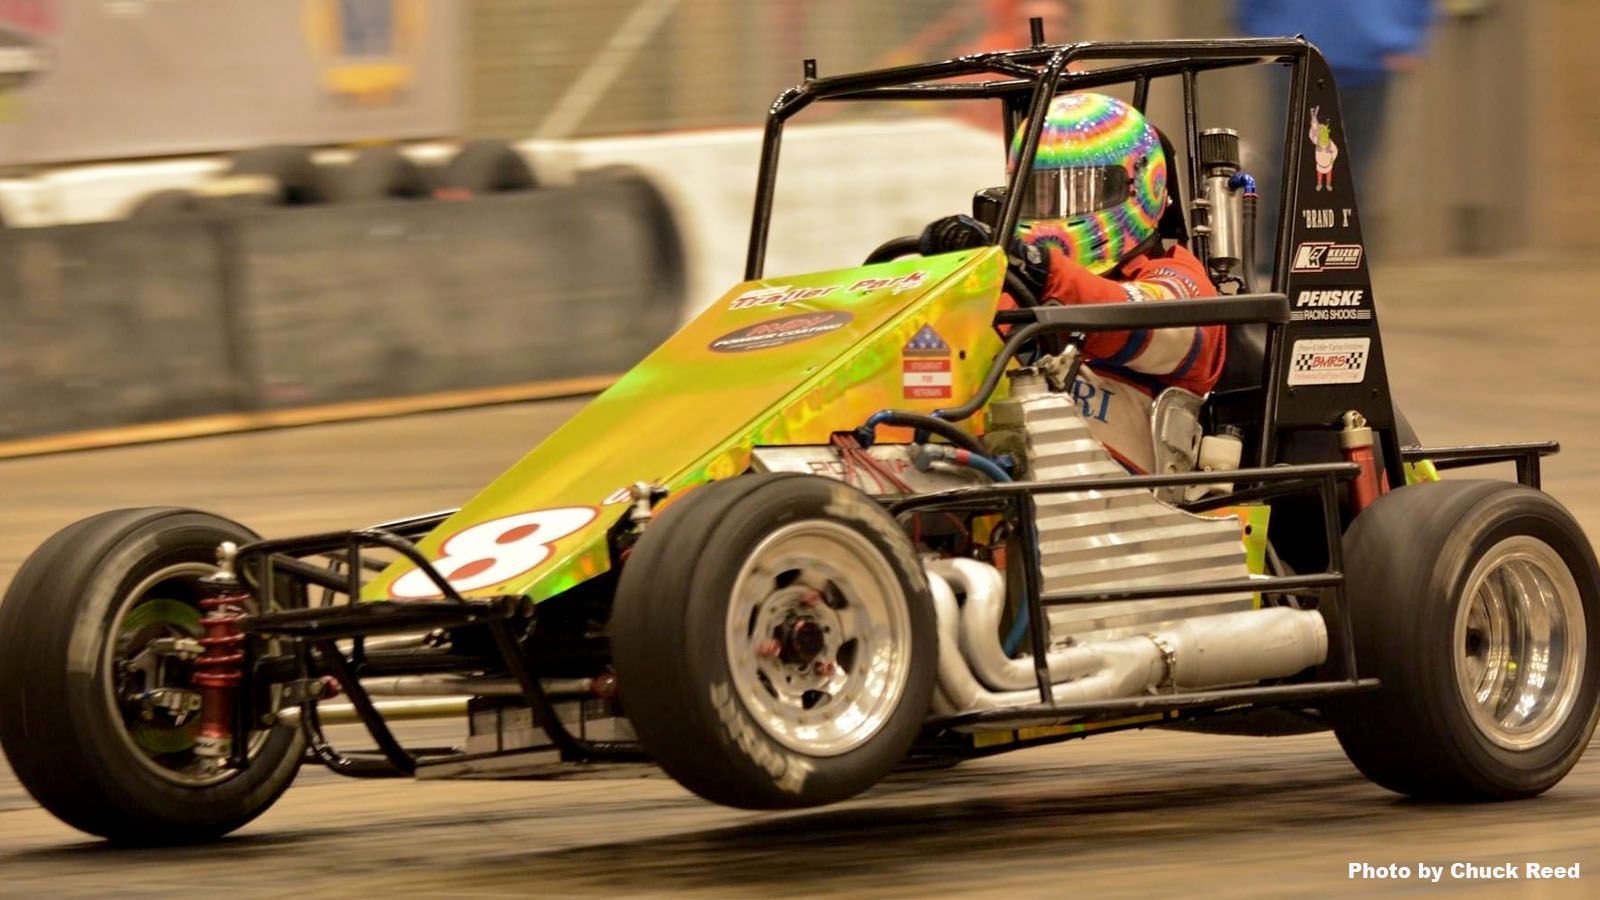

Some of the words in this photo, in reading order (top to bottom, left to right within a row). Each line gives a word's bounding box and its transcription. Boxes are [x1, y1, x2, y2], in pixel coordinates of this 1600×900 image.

[1296, 290, 1363, 307] PENSKE
[1304, 309, 1329, 320] RACING
[1329, 309, 1357, 320] SHOCKS
[388, 506, 601, 599] 8
